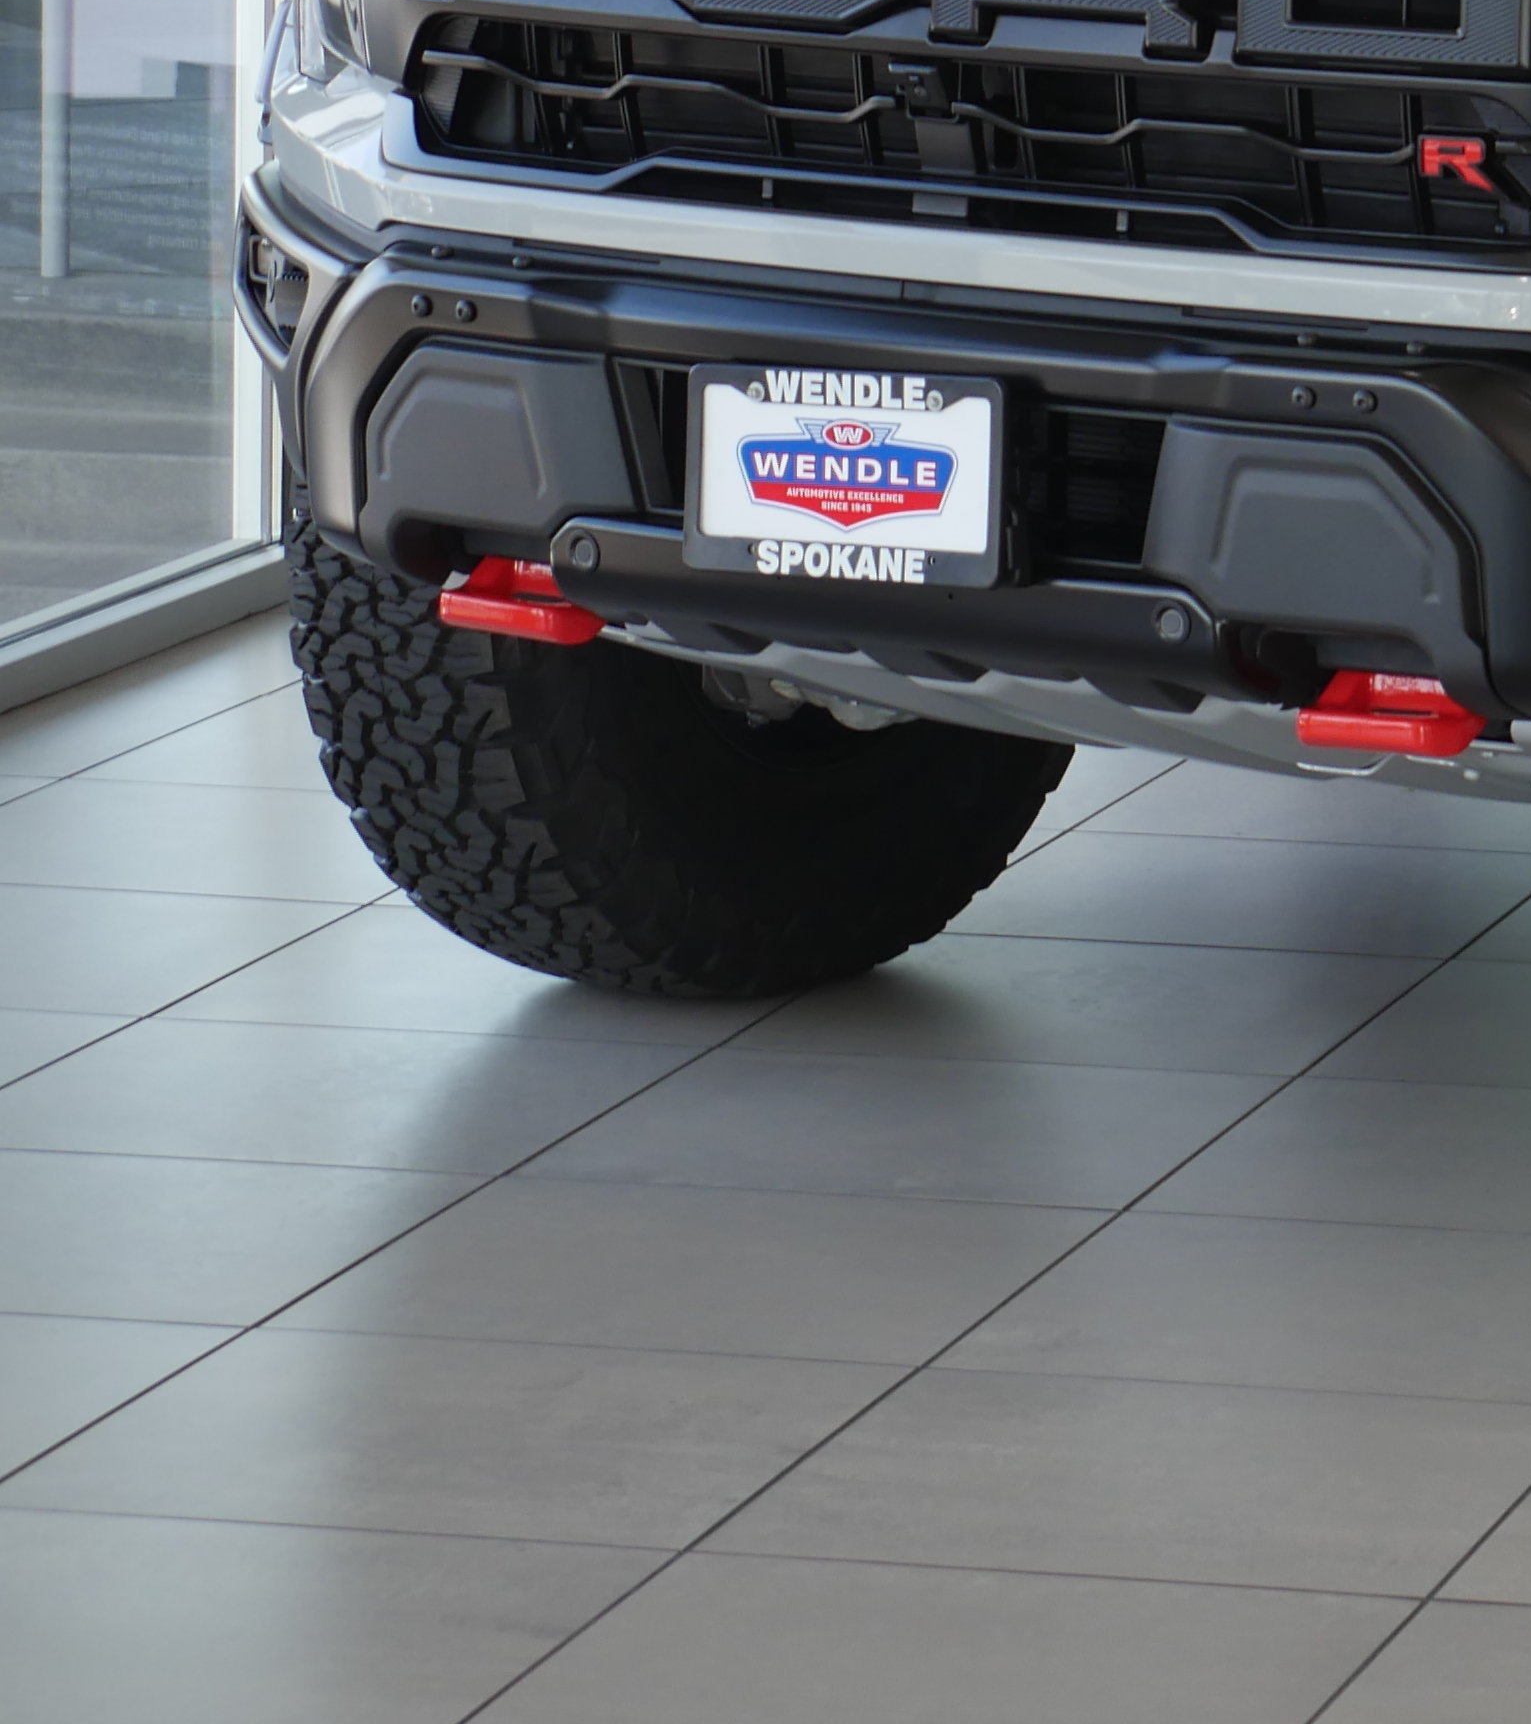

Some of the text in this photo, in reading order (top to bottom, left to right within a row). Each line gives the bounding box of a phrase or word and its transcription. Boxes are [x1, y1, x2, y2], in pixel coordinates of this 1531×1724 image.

[1419, 135, 1496, 193] R
[765, 369, 927, 411] WENDLE
[753, 451, 937, 487] WENDLE
[786, 487, 905, 504] AUTOMOTIVE EXCELLENCE
[821, 501, 872, 513] SINCE 1943
[756, 539, 926, 584] SPOKANE
